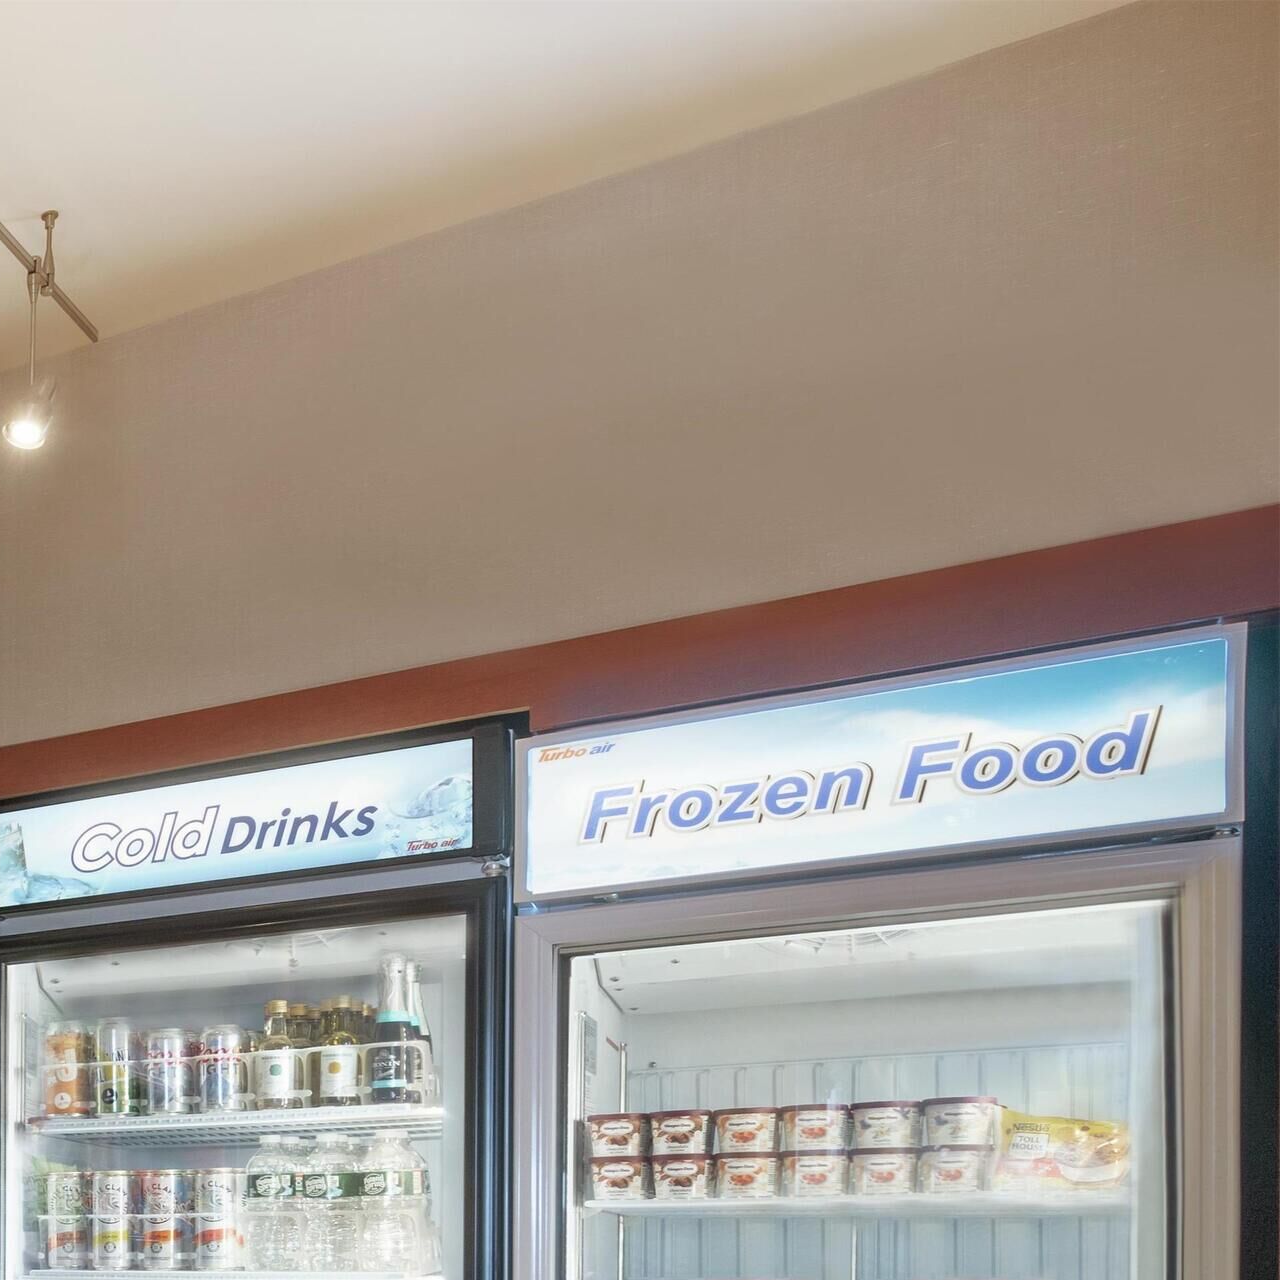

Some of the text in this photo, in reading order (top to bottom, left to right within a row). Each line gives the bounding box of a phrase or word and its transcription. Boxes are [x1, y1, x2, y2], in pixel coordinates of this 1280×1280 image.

[537, 740, 617, 764] Turbo air
[579, 704, 1163, 845] Frozen Food
[70, 800, 379, 874] Cold Drinks
[406, 838, 438, 853] Turbo
